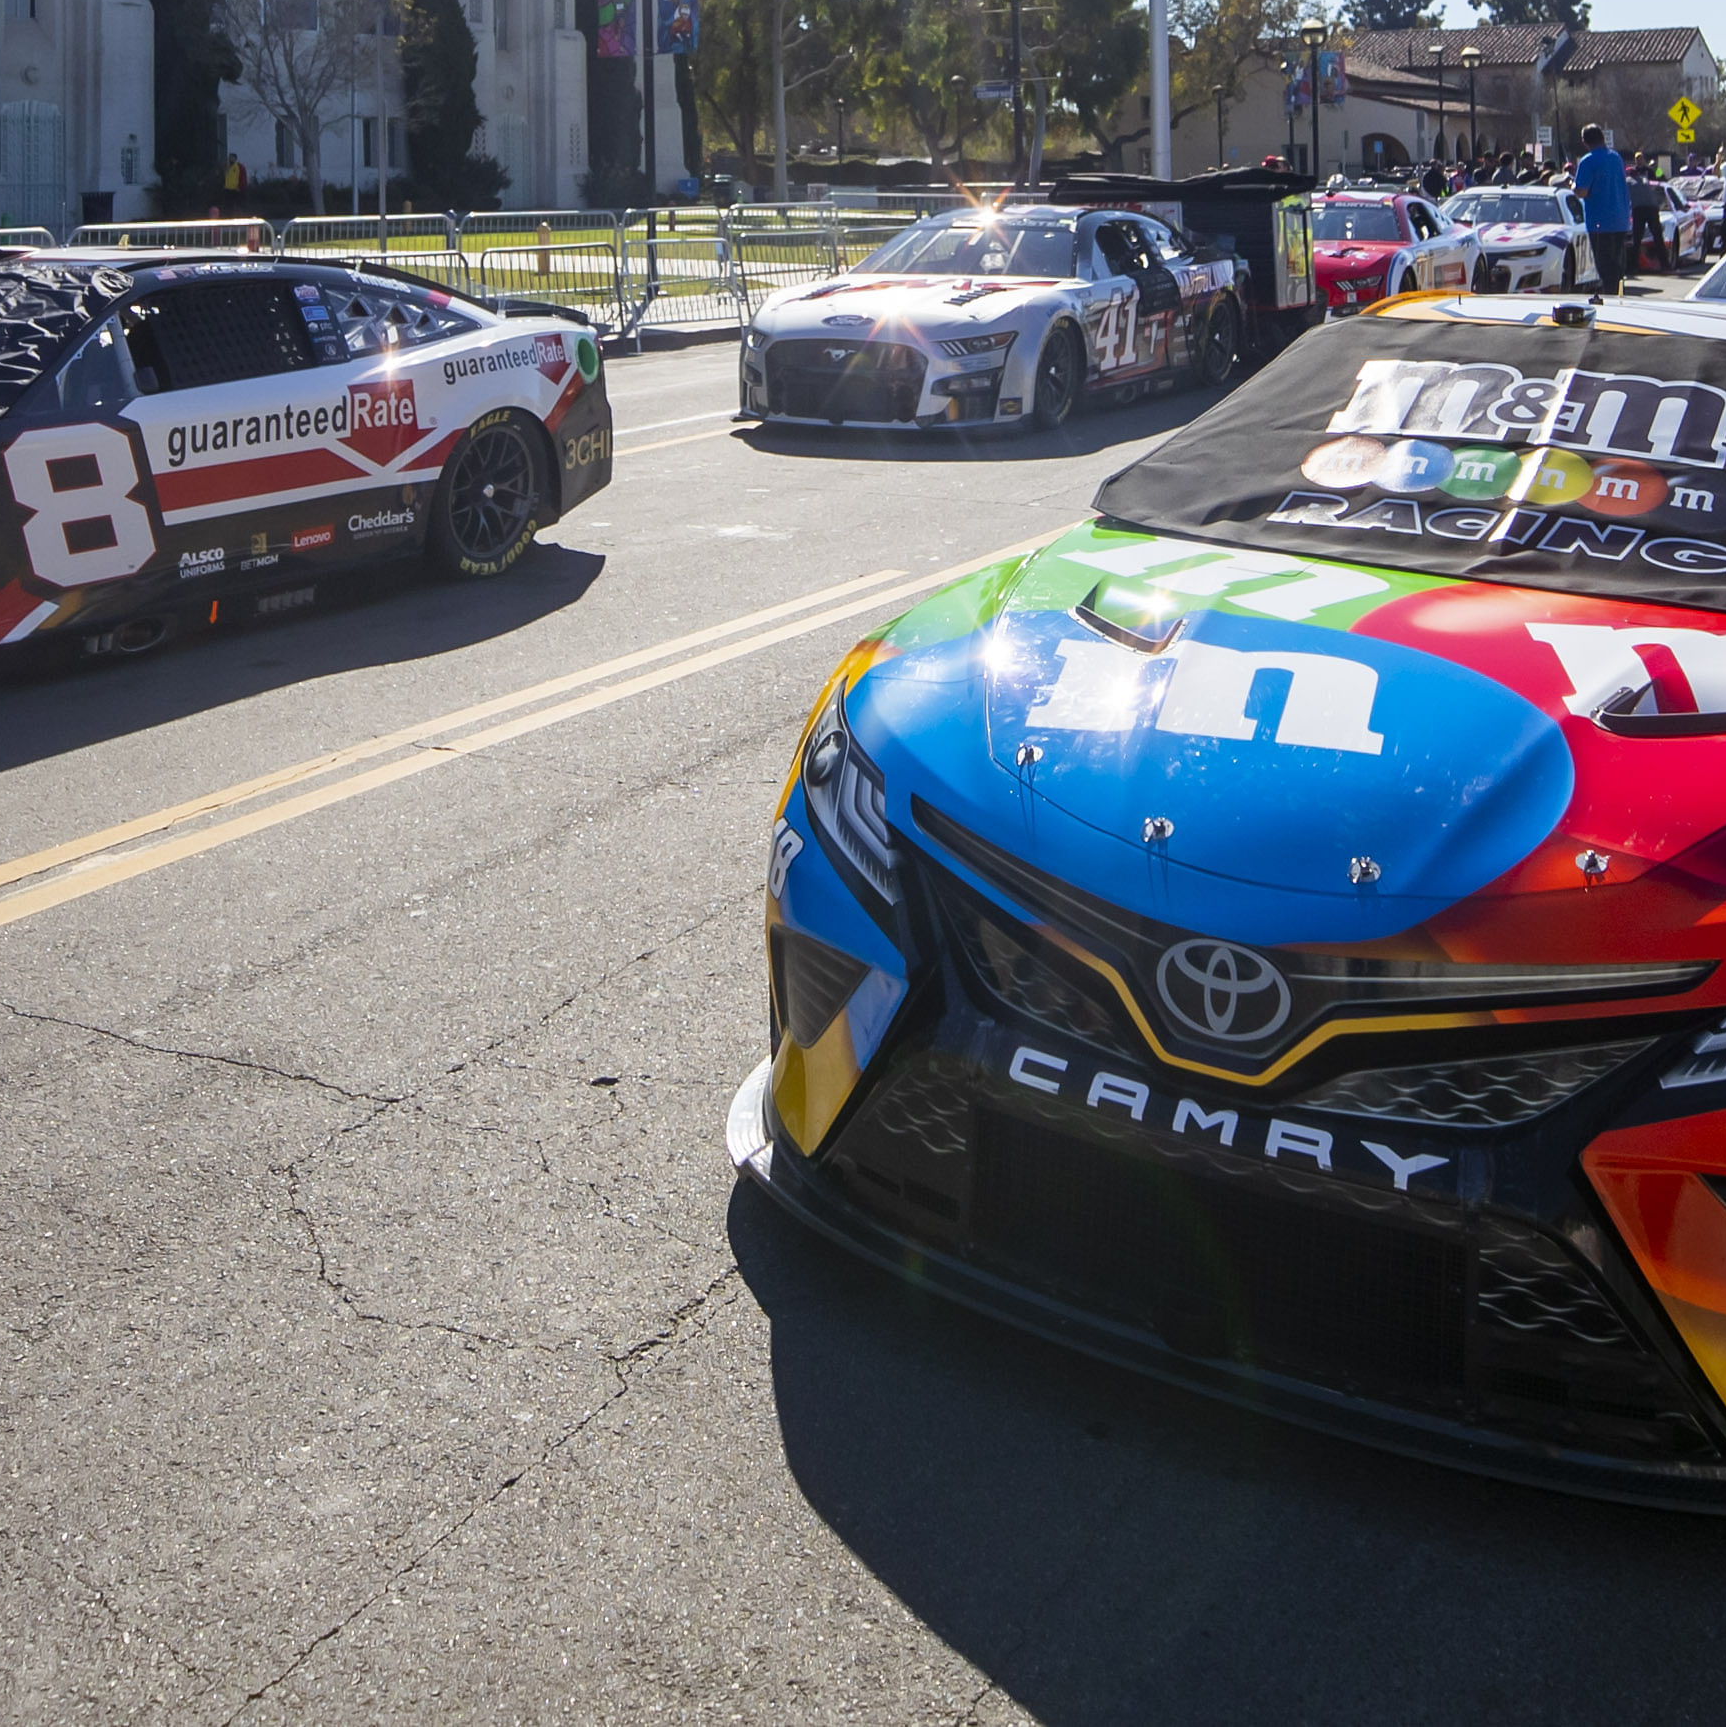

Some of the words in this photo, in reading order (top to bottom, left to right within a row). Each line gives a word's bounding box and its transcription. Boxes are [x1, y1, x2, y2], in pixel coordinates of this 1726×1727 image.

[1095, 286, 1141, 372] 41
[443, 343, 538, 385] guaranteed
[536, 340, 565, 363] Rate
[167, 395, 350, 467] guaranteed
[353, 392, 415, 429] Rate
[470, 410, 512, 439] EAGLE
[566, 428, 610, 470] 3CHI
[4, 422, 157, 587] 8
[1457, 457, 1496, 483] m
[1595, 474, 1641, 502] m
[1671, 483, 1714, 513] m
[294, 530, 332, 549] Lenovo
[348, 507, 415, 533] Cheddar's
[180, 561, 225, 579] UNIFORMS
[240, 553, 279, 571] BETMGM
[460, 519, 538, 575] GOODYEAR
[1058, 536, 1391, 621] m
[1008, 1045, 1450, 1191] CAMRY
